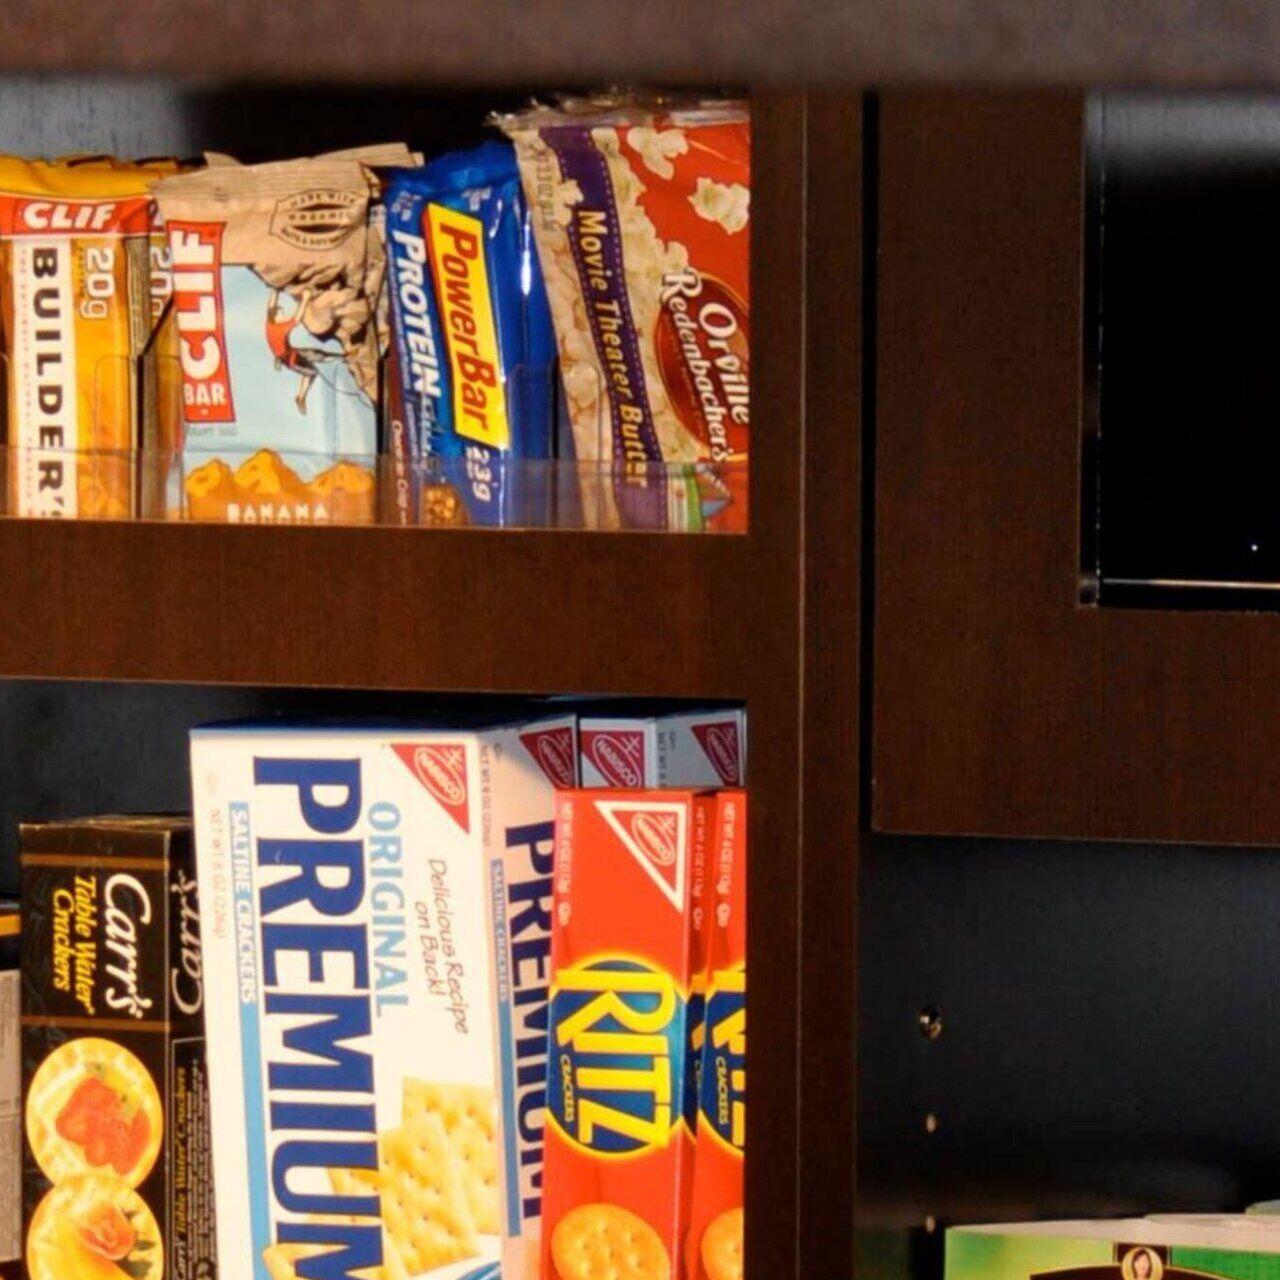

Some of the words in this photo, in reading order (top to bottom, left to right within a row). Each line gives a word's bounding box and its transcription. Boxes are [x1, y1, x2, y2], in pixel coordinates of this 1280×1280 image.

[22, 202, 116, 229] CLIF
[80, 246, 115, 320] 20g
[171, 230, 222, 381] CLIF
[392, 230, 442, 399] PROTEIN
[440, 222, 497, 432] PowerBar
[578, 209, 609, 293] Movie
[598, 300, 632, 397] Theater
[618, 398, 651, 488] Butter
[662, 267, 734, 464] Redenbacher's
[698, 302, 750, 424] Orville
[183, 383, 227, 406] BAR
[226, 502, 332, 523] BANANA
[52, 888, 76, 992] Crackers
[76, 875, 98, 937] Table
[105, 872, 153, 1020] Carr's
[368, 801, 409, 1018] ORIGINAL
[415, 901, 431, 931] on
[428, 858, 455, 963] Delicious
[444, 962, 469, 1035] Recipe
[74, 938, 100, 1015] Water
[554, 968, 676, 1147] RITZ
